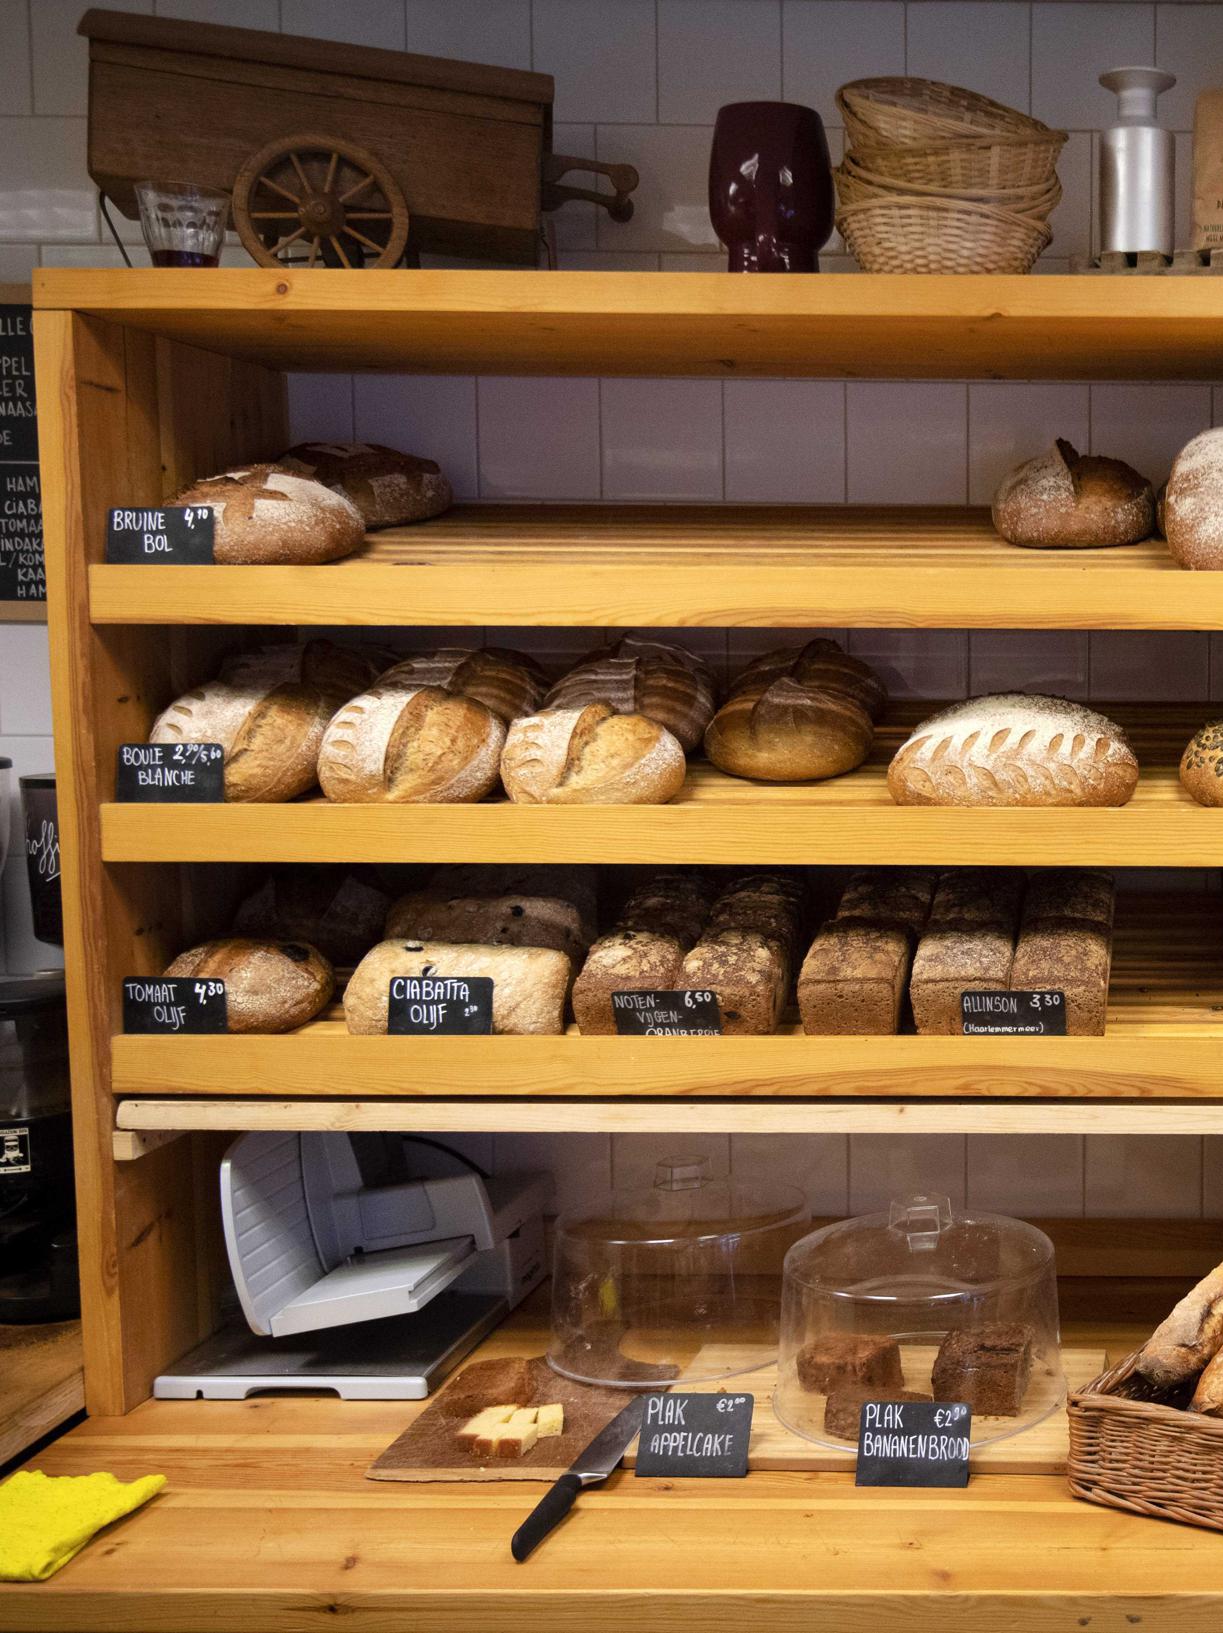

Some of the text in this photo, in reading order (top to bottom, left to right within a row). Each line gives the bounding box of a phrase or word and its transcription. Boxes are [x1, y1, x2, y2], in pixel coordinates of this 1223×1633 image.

[0, 356, 31, 376] PEL
[113, 510, 166, 531] BRUINE
[144, 533, 173, 554] BOL
[122, 746, 164, 766] BOULE
[138, 767, 196, 787] BLANCHE
[125, 983, 178, 1003] TOMAAT
[392, 979, 470, 1002] CIABATTA
[963, 995, 1018, 1013] ALLINSON
[153, 1006, 187, 1030] OLIJF
[410, 1003, 448, 1030] OLIJF
[647, 1396, 689, 1425] PLAK
[865, 1403, 904, 1429] PLAK
[650, 1432, 734, 1457] APPELCAKE
[863, 1431, 970, 1461] BANANENBROOD
